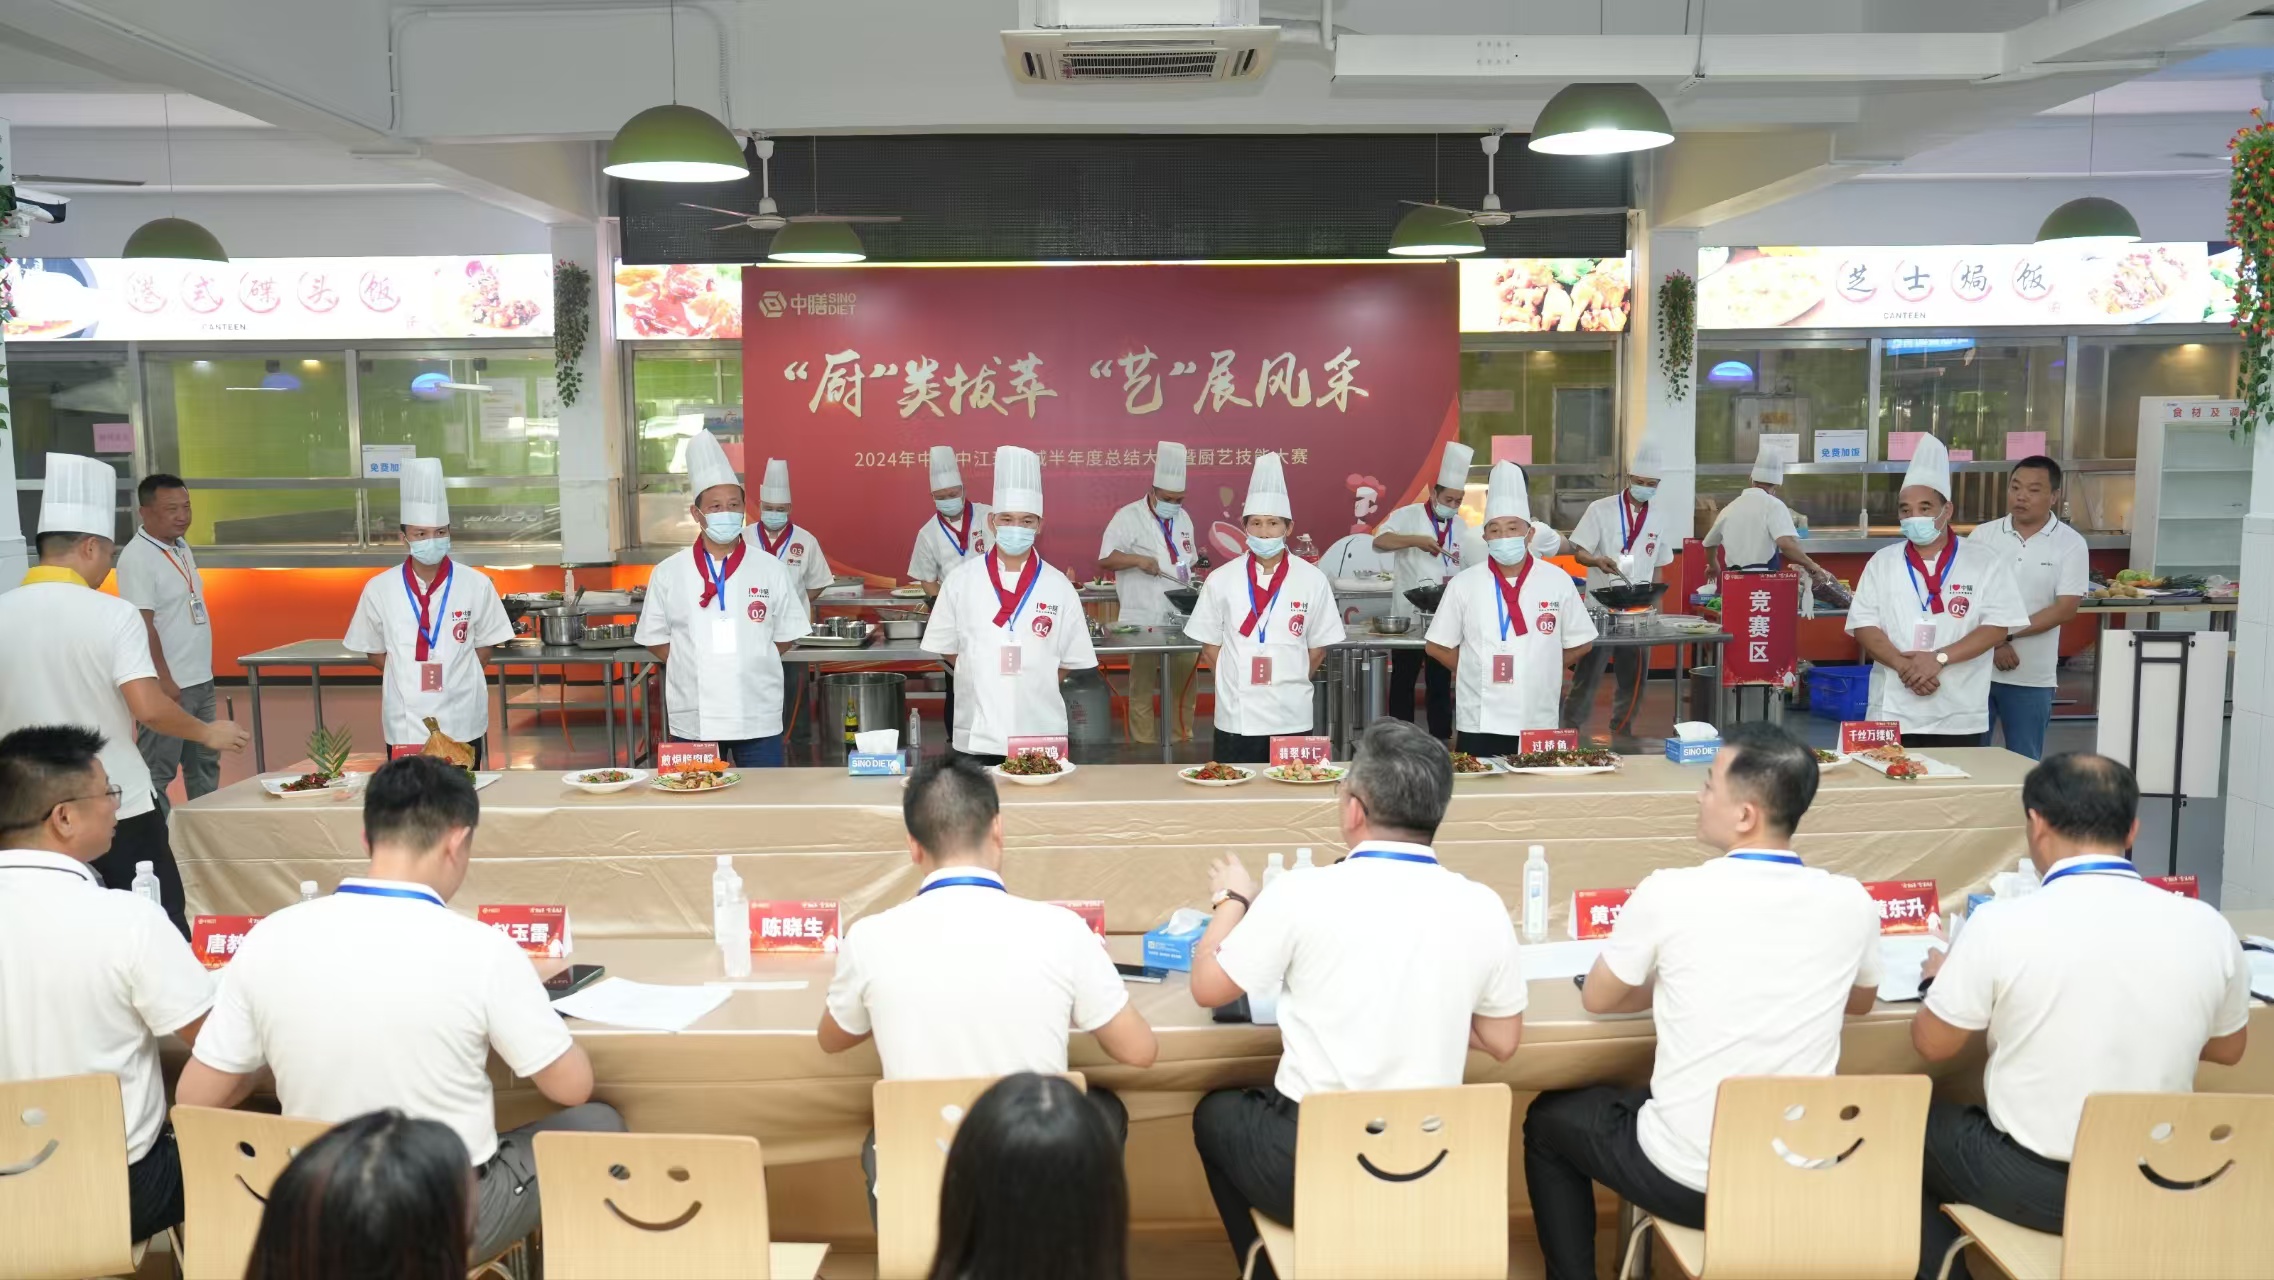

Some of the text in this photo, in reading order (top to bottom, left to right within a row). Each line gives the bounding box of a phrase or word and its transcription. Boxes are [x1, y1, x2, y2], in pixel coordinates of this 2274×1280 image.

[1847, 263, 2046, 292] 芝士焗饭
[828, 293, 857, 304] SINO
[790, 293, 828, 316] 中膳
[828, 304, 857, 315] DIET
[1884, 312, 1926, 320] CANTEEN
[1821, 447, 1861, 458] 免费加饭
[370, 462, 402, 473] 免费加
[751, 608, 765, 619] 02
[1951, 603, 1967, 615] 05
[1035, 622, 1049, 635] 04
[1540, 620, 1554, 631] 08
[1748, 589, 1772, 663] 竞赛区
[1532, 739, 1567, 753] 过桥鱼
[1279, 746, 1322, 760] 翡翠虾仁
[1683, 748, 1702, 756] SINO
[851, 759, 892, 768] SINO DIET
[761, 916, 824, 938] 陈晓生
